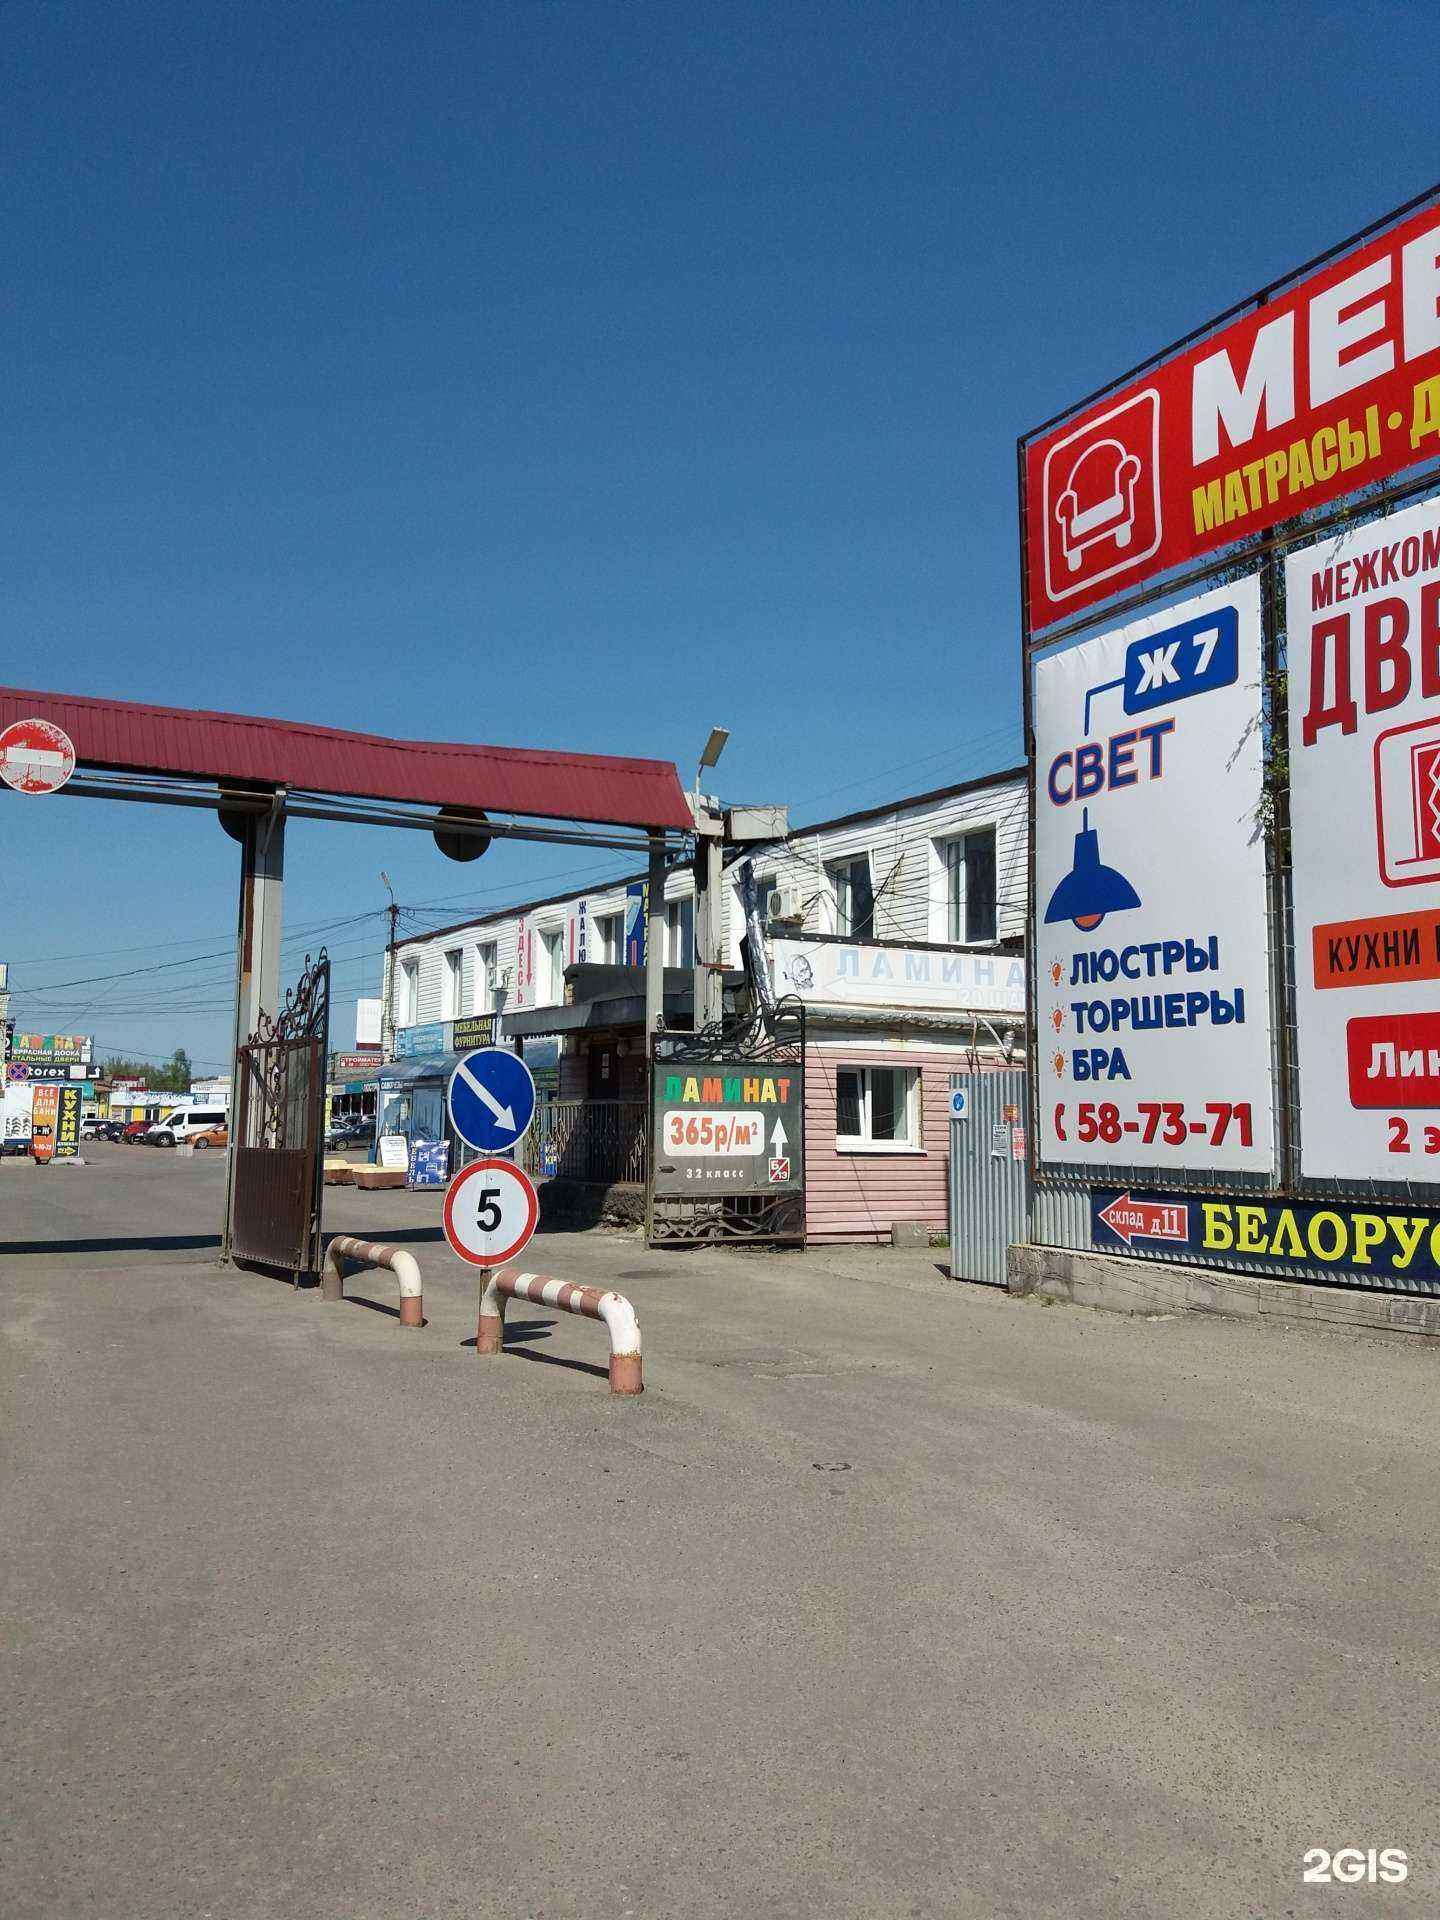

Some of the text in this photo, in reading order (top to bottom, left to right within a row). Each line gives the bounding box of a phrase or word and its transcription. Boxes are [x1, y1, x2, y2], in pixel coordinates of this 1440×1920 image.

[1192, 404, 1382, 535] МАТРАСЫ
[1134, 627, 1219, 695] Ж 7
[1048, 717, 1175, 807] СВЕТ
[836, 948, 1024, 988] ЛАМИНА
[1070, 936, 1218, 985] ЛЮСТРЫ
[1328, 928, 1420, 974] КУХНИ
[455, 1019, 491, 1032] МЕБЕЛЬНАЯ
[1071, 988, 1245, 1033] ТОРШЕРЫ
[455, 1034, 491, 1047] ФУРНИТУРА
[28, 1066, 65, 1076] torex
[1072, 1048, 1132, 1081] БРА
[664, 1076, 790, 1104] ЛАМИНАТ
[61, 1090, 77, 1141] КУХНИ
[1078, 1103, 1253, 1147] 58-73-71
[1388, 1117, 1410, 1152] 2
[686, 1168, 744, 1179] 32 класс
[476, 1189, 502, 1232] 5
[1109, 1210, 1144, 1230] склад
